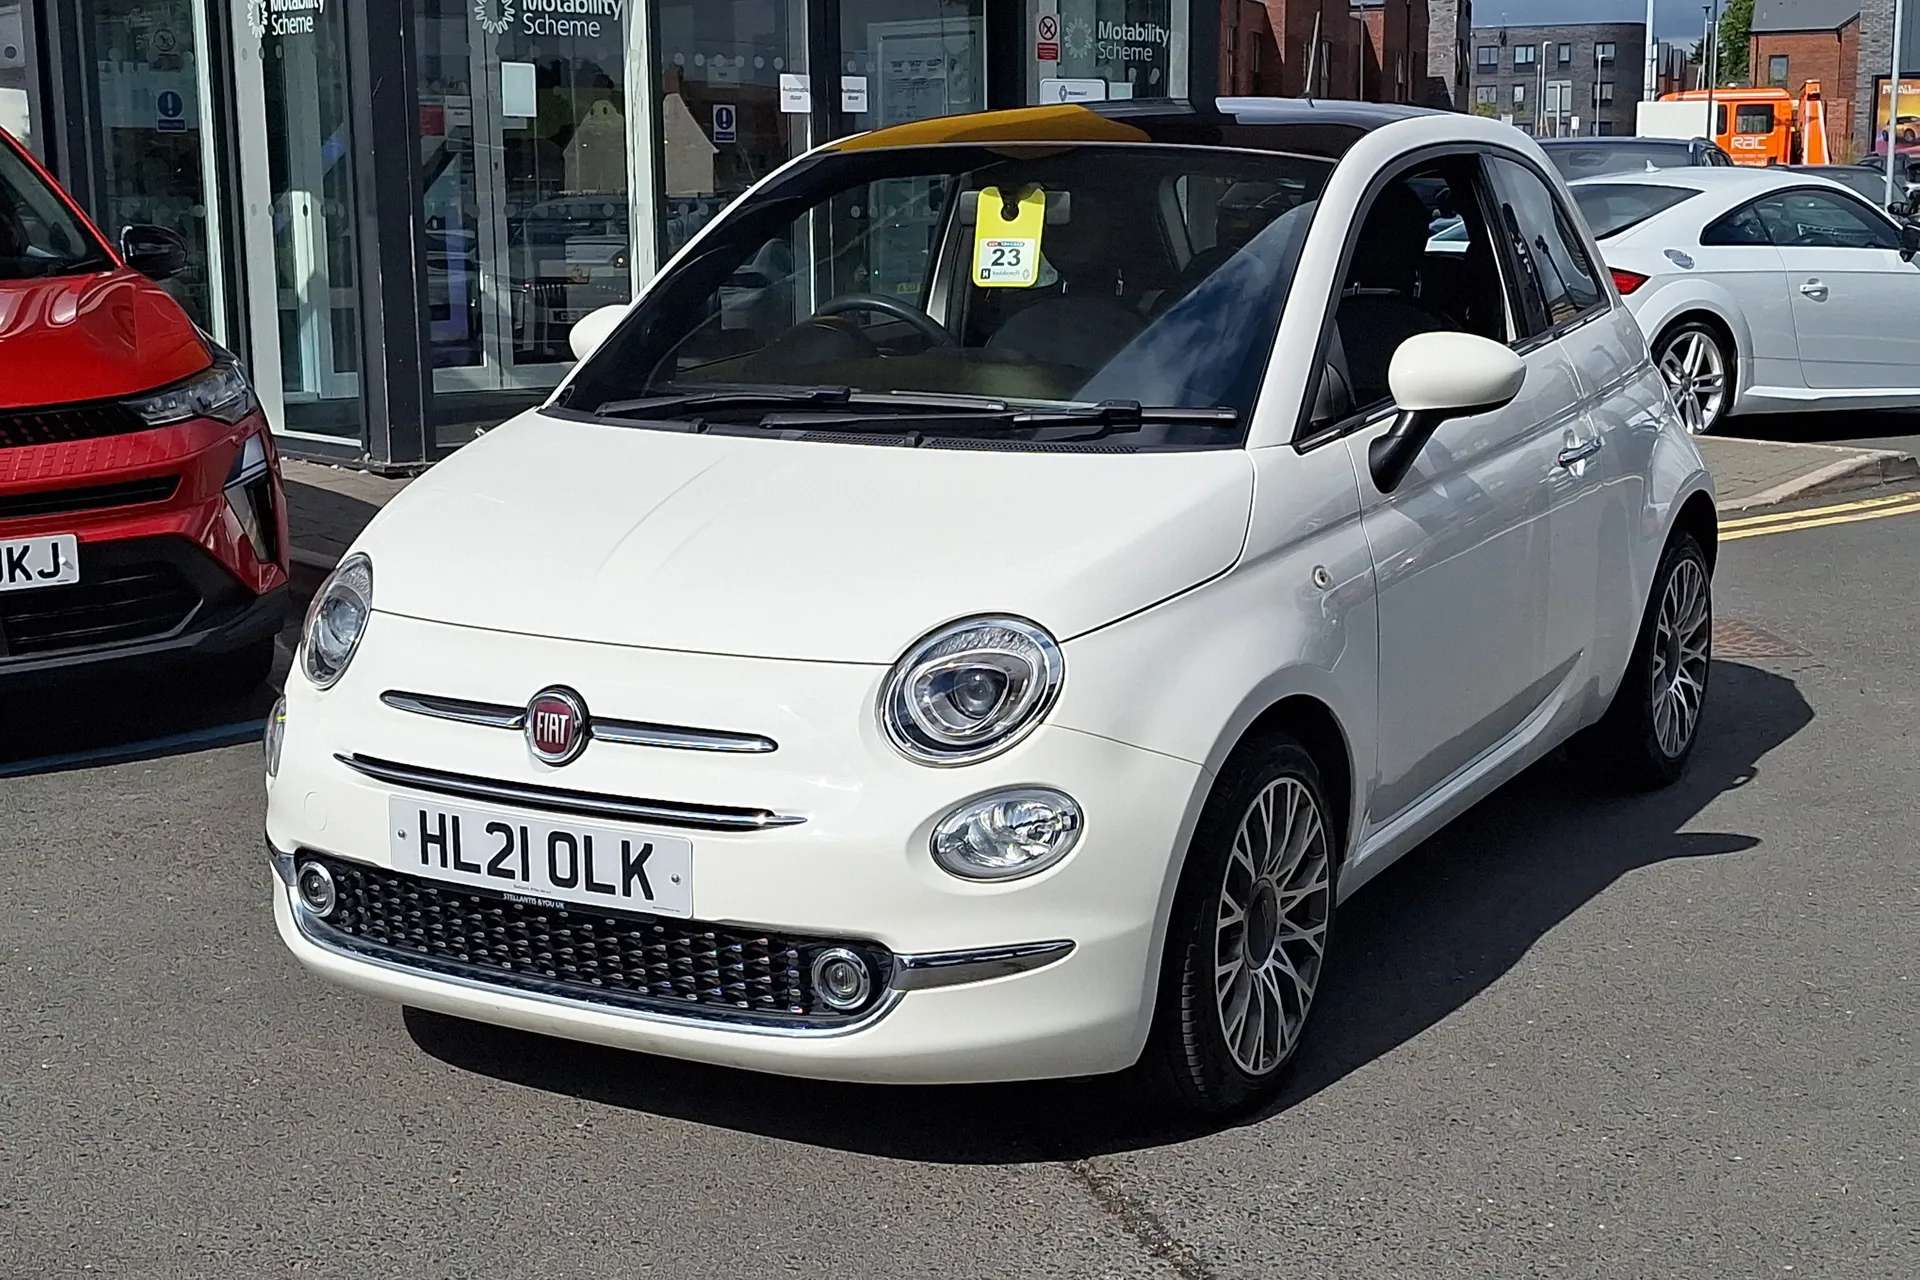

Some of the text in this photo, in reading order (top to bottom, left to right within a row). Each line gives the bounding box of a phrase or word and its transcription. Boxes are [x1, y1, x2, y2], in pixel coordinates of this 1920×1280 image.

[271, 13, 314, 36] Scheme
[523, 13, 601, 37] Scheme
[1098, 20, 1170, 48] Motability
[1098, 41, 1153, 62] Scheme
[991, 248, 1021, 267] 23
[0, 542, 61, 583] KJ
[536, 711, 570, 745] FIAT
[419, 809, 655, 901] HL21 OLK
[503, 893, 536, 904] STELLANTIS
